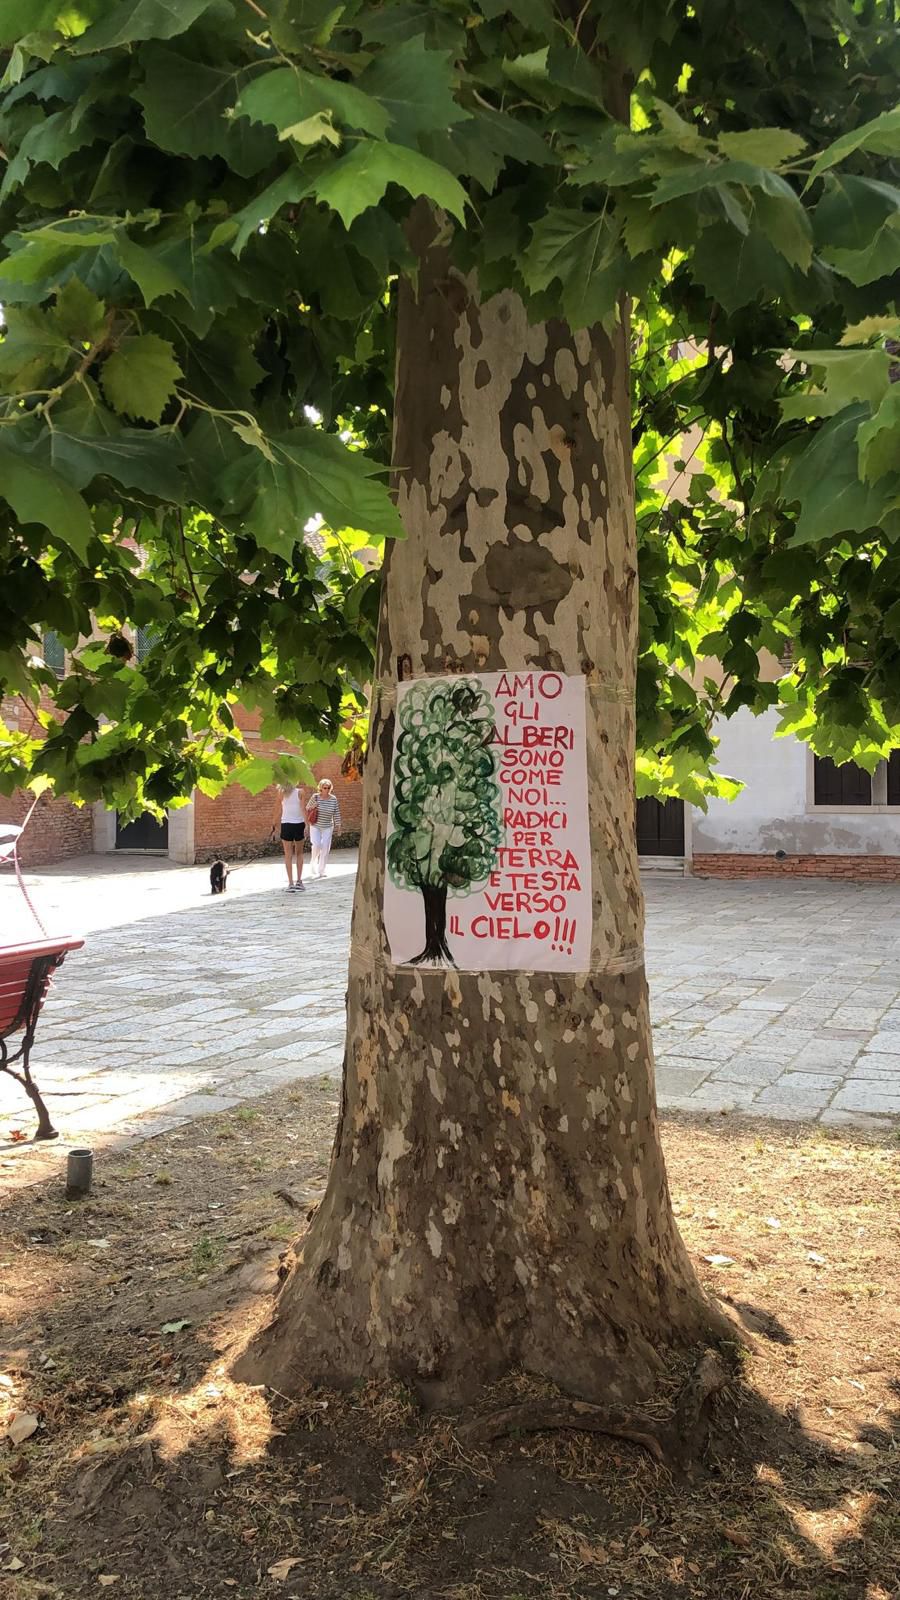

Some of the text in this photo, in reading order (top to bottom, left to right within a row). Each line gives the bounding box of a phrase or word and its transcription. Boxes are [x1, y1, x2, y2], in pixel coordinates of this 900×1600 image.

[495, 673, 563, 699] AMO
[503, 701, 540, 726] GLI
[484, 725, 574, 750] ALBERI
[500, 749, 564, 768] SONO
[500, 769, 564, 786] COME
[508, 787, 567, 806] NOI...
[504, 808, 567, 829] RADICI
[512, 831, 553, 847] PER
[493, 847, 580, 871] TERRA
[490, 871, 581, 891] E TESTA
[484, 891, 567, 913] VERSO
[450, 915, 577, 955] IL CIELO!!!
